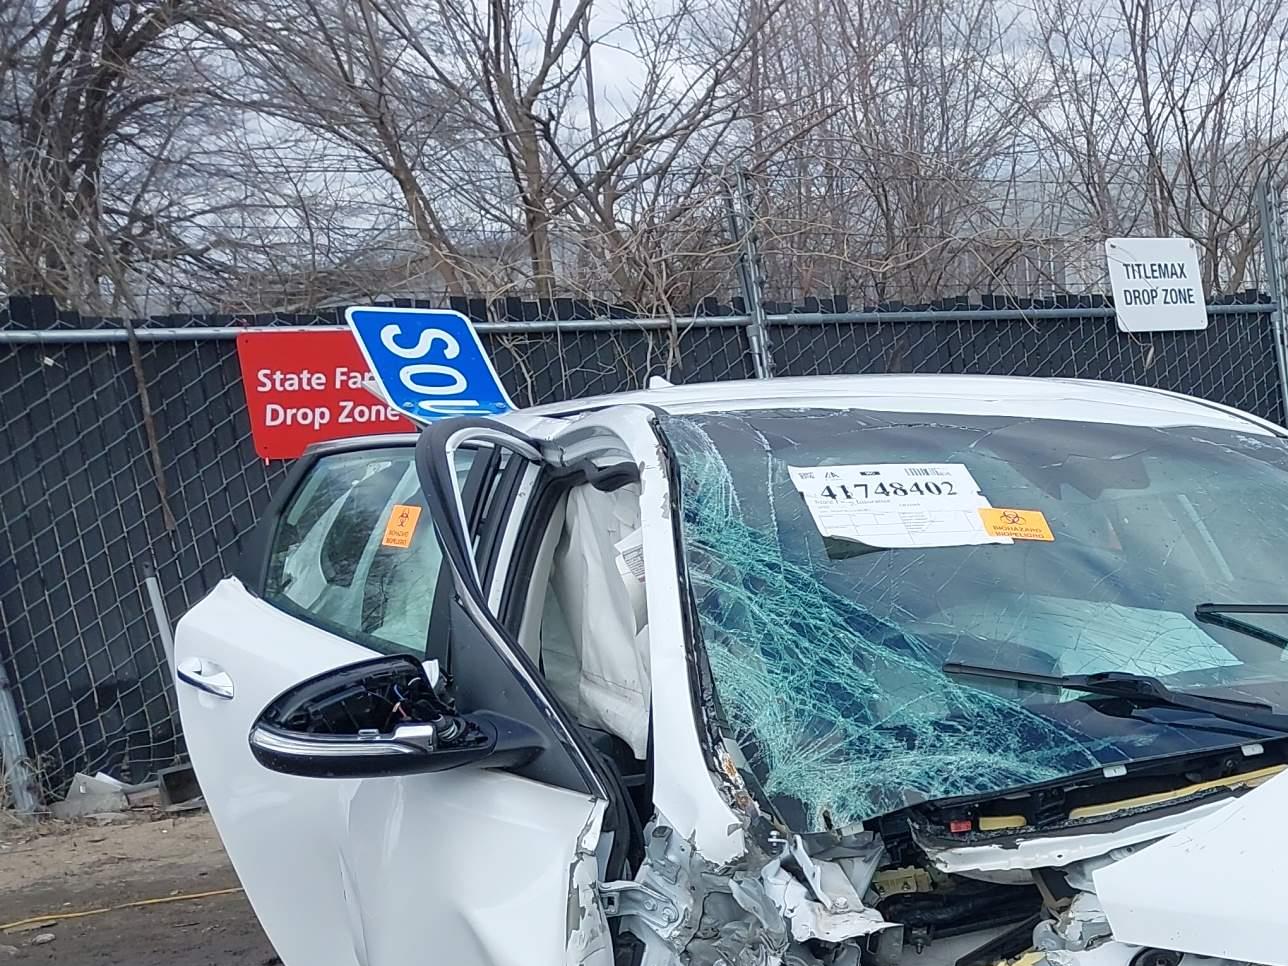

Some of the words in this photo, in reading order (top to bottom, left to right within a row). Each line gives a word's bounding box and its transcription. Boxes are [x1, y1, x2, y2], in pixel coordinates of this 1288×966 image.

[1123, 263, 1187, 279] TITLEMAX
[1124, 289, 1158, 306] DROP
[1162, 288, 1195, 305] ZONE
[257, 369, 327, 392] State
[335, 367, 378, 390] Far
[265, 403, 331, 430] Drop
[338, 401, 400, 423] Zone
[820, 481, 957, 500] 41748402
